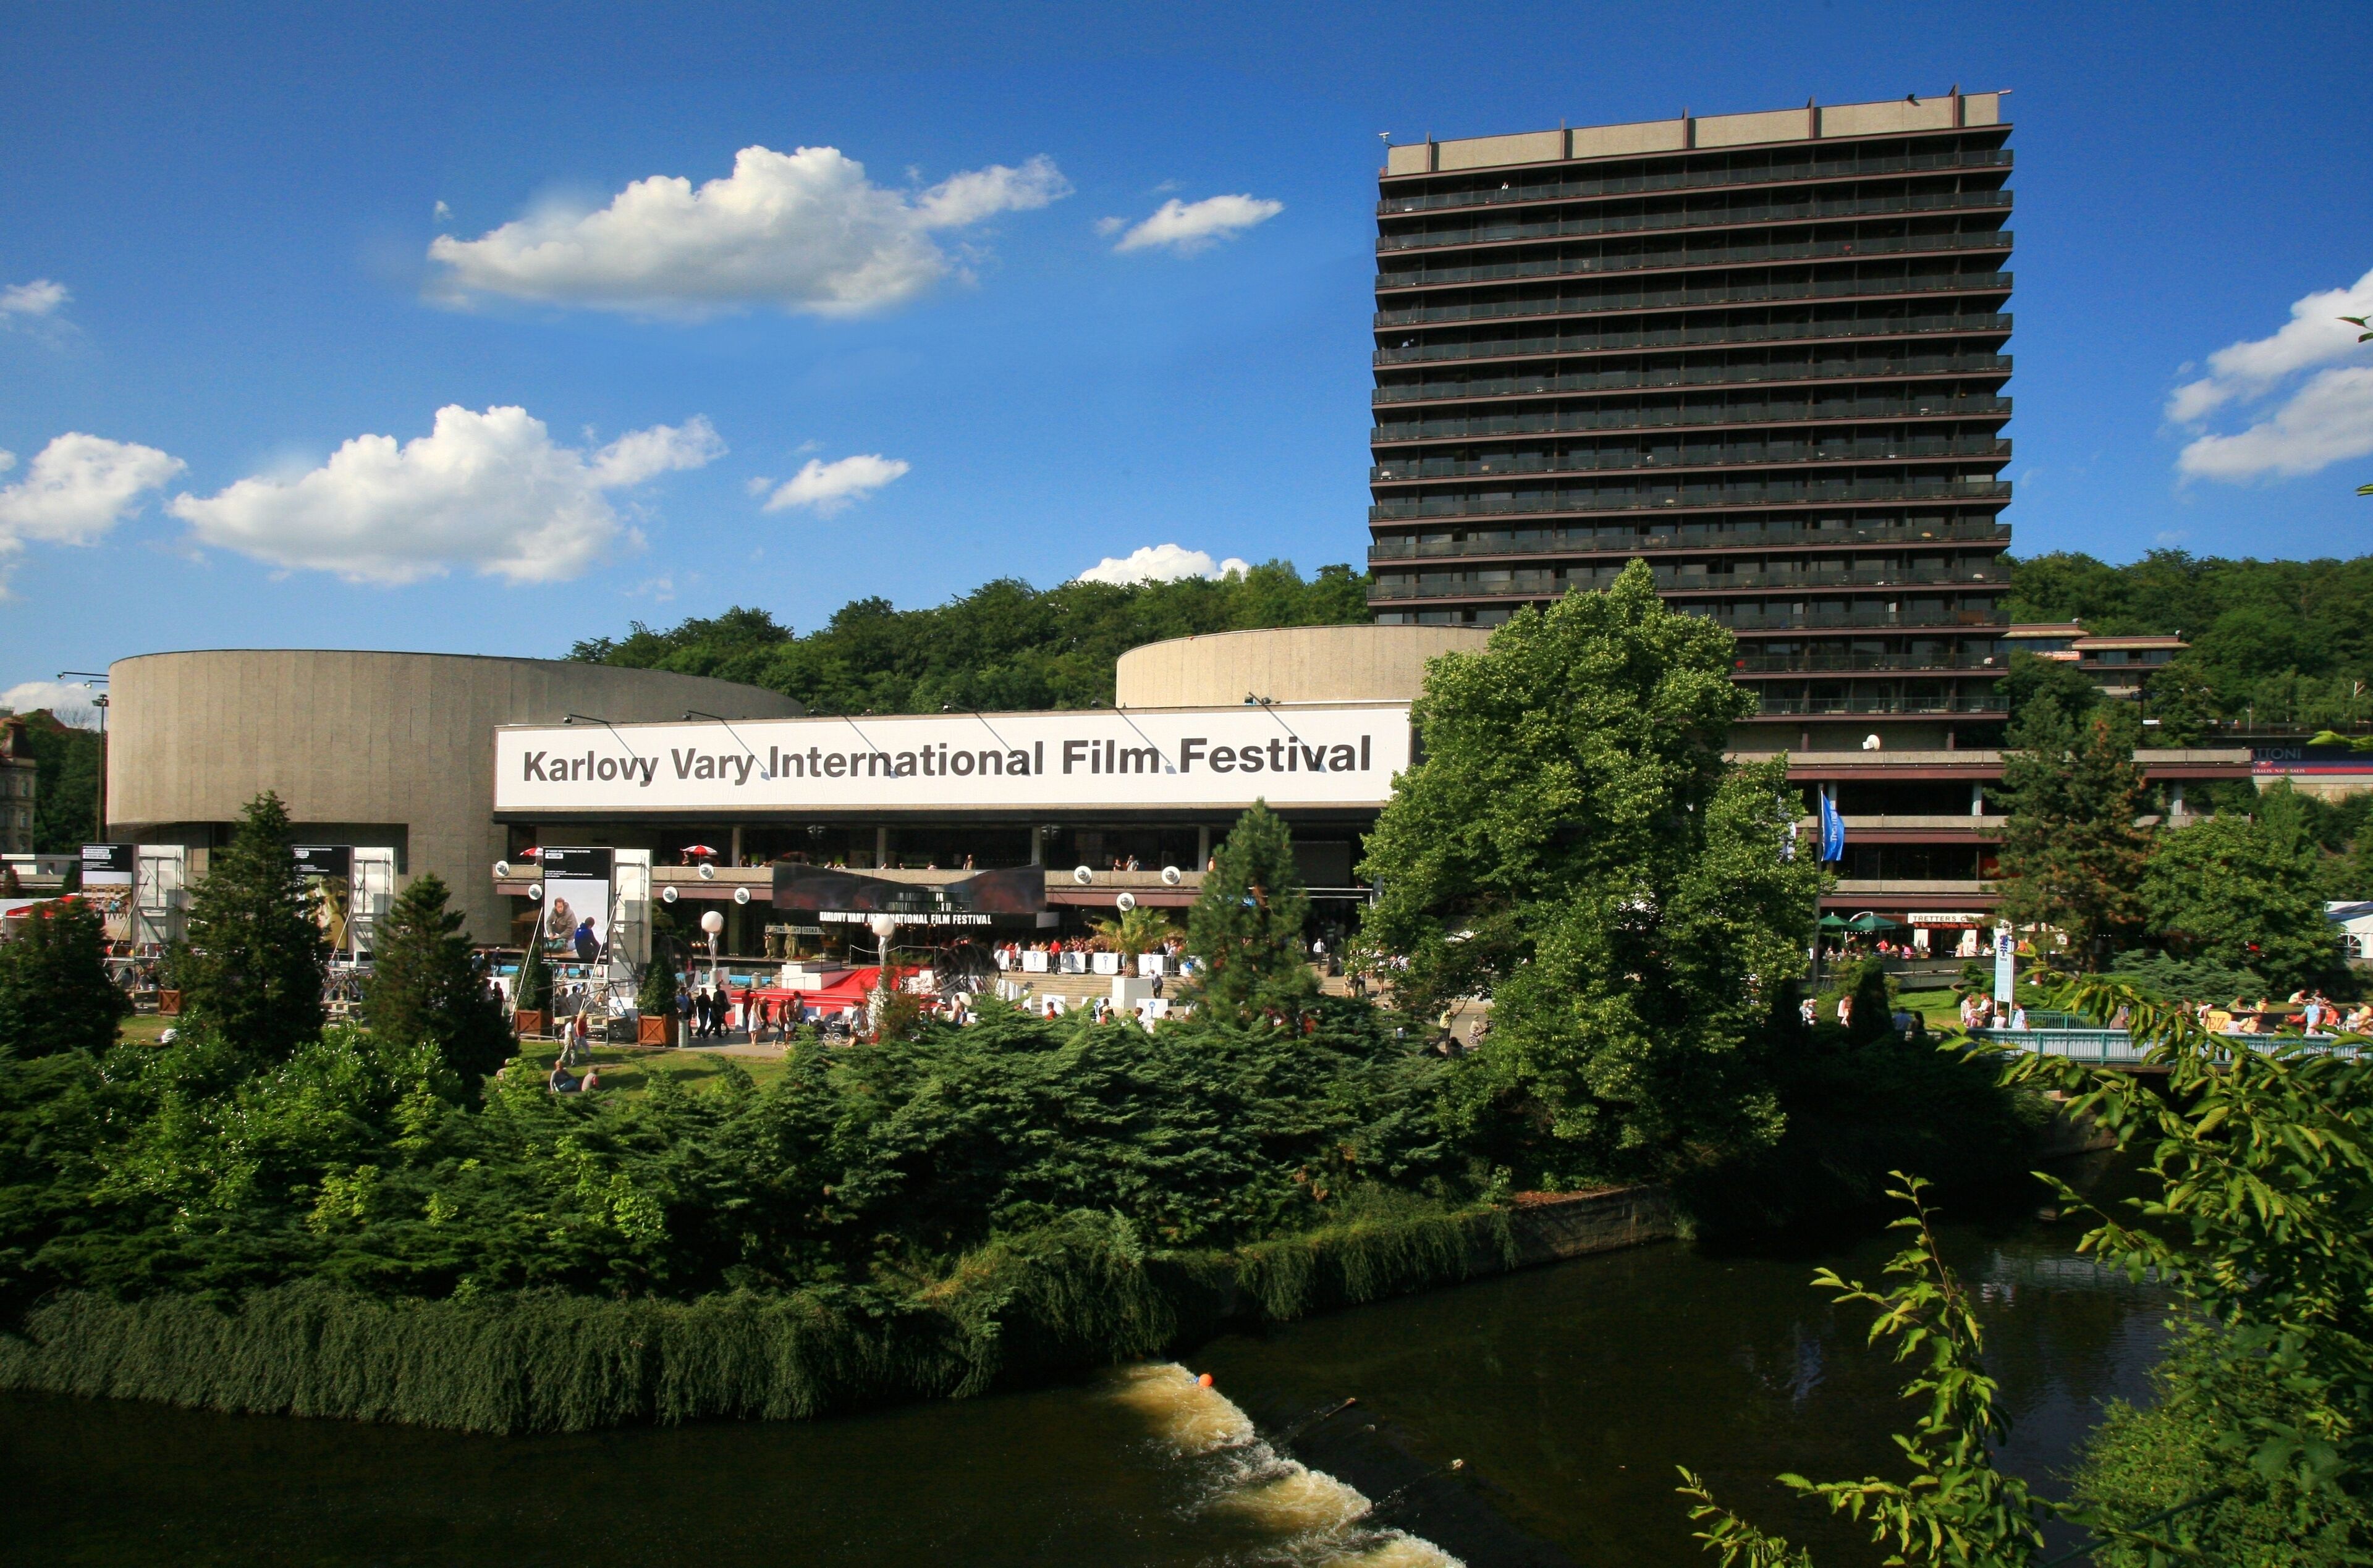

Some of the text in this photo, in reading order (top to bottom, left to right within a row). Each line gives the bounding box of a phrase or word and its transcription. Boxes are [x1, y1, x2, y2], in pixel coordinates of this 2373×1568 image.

[2252, 747, 2302, 760] TTONI
[524, 735, 1371, 788] Karlovy Vary International Film Festival
[819, 911, 992, 925] KARLOVY VARY INNATIONAL FILM FESTIVAL
